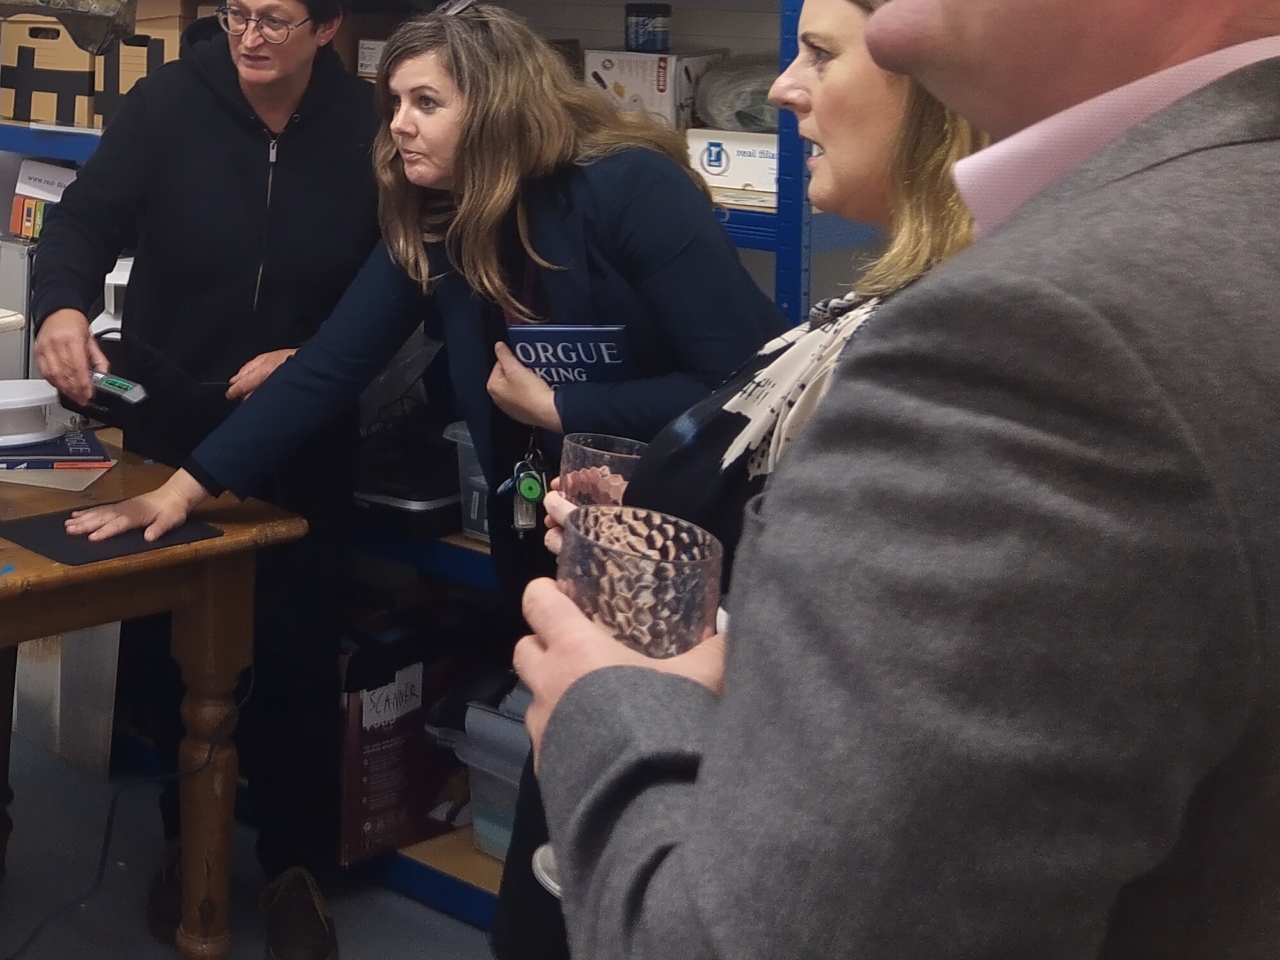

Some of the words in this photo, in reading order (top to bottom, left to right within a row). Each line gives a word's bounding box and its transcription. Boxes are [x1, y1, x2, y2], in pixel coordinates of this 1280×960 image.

[736, 148, 757, 158] real
[757, 149, 779, 160] fila
[515, 341, 624, 364] ORGUE
[535, 367, 588, 382] KING
[368, 683, 419, 714] SCANNER
